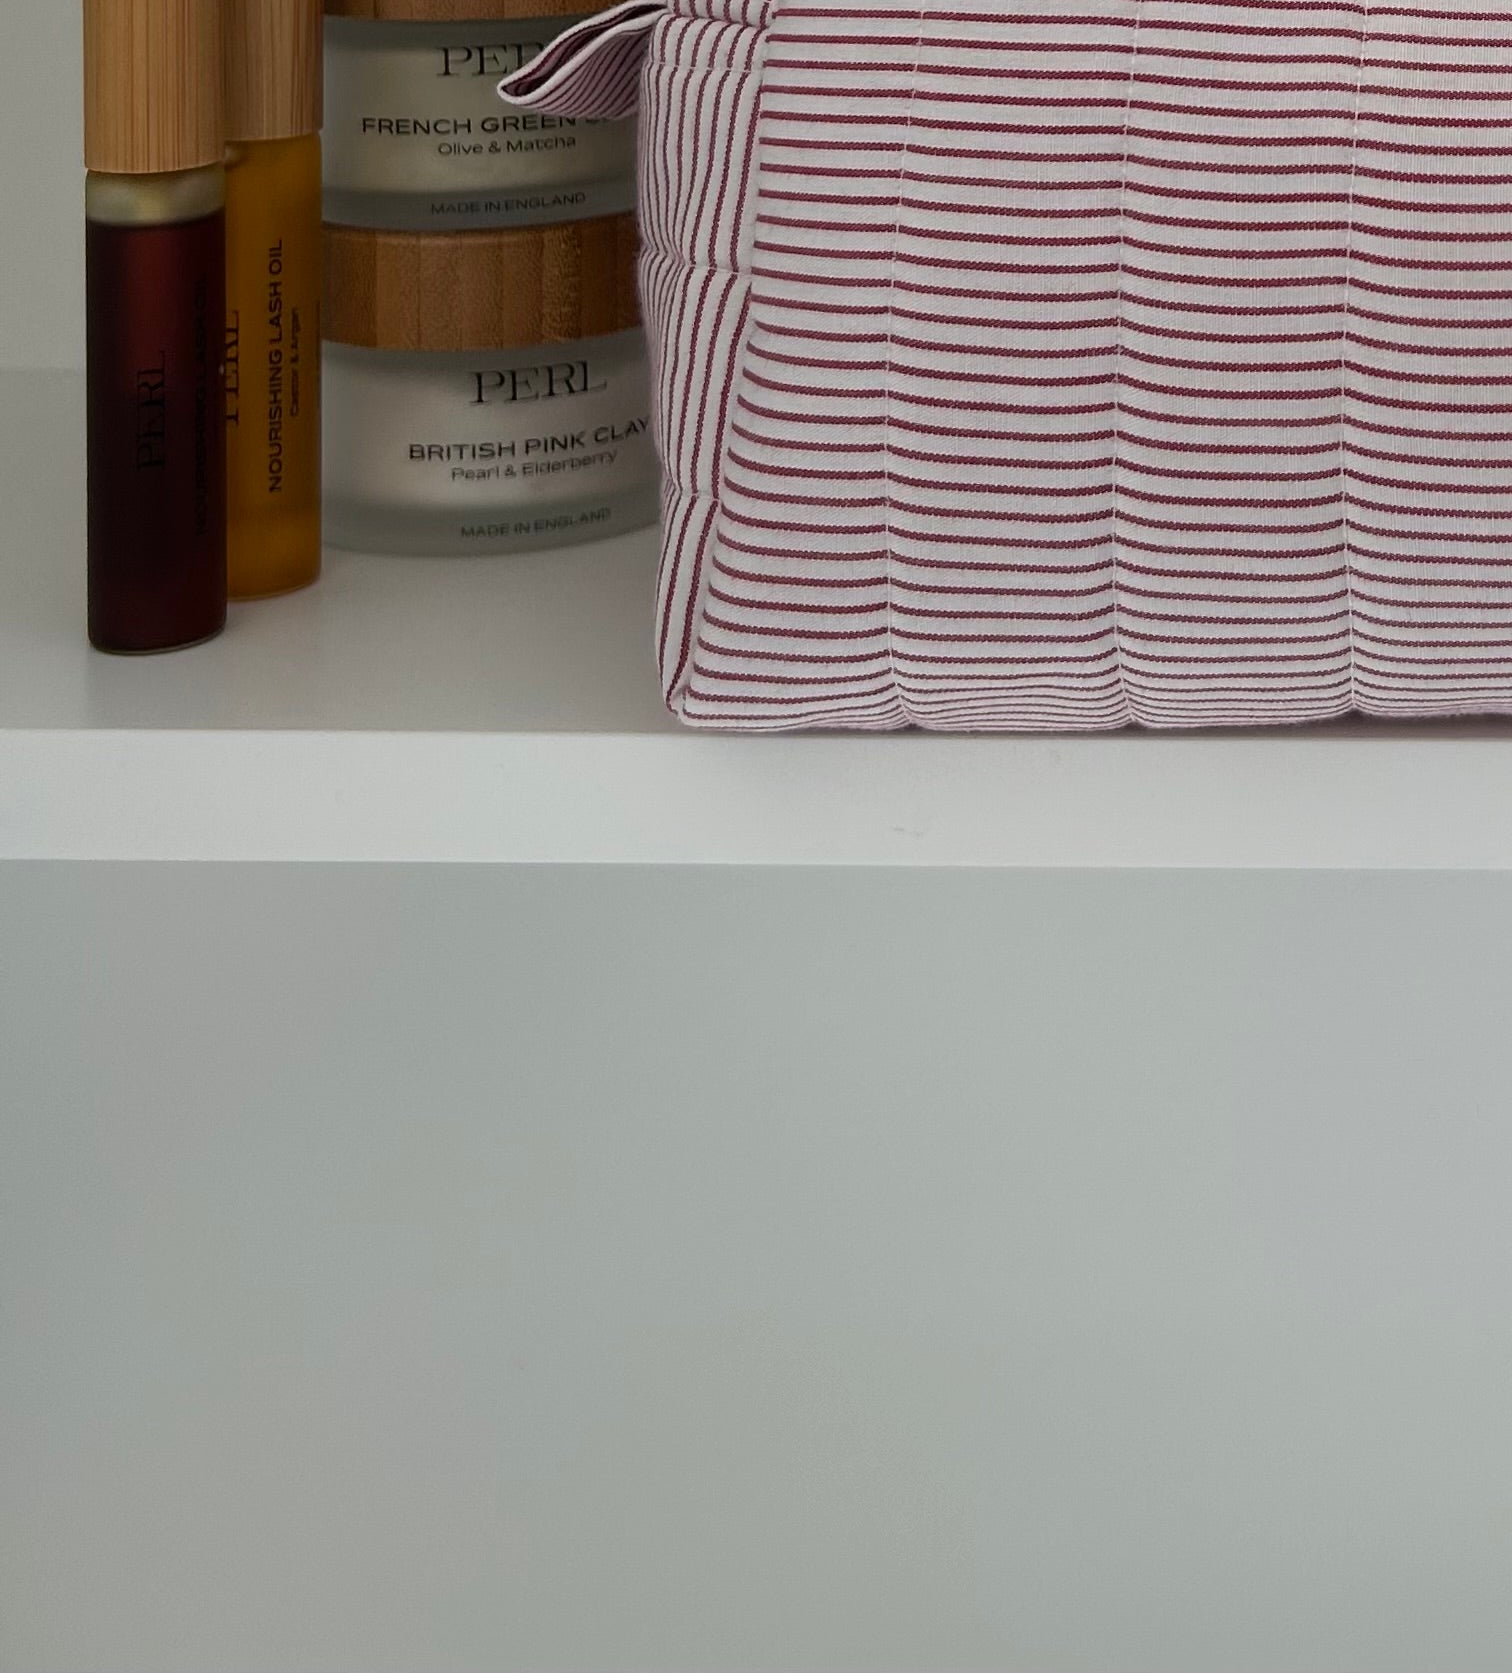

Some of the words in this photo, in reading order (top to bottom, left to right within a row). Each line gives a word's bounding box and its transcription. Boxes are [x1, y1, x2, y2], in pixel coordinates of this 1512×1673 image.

[362, 117, 471, 135] FRENCH
[437, 141, 483, 156] Olive
[488, 140, 501, 154] &
[506, 135, 577, 153] Matcha
[431, 202, 481, 216] MADE
[484, 201, 501, 213] IN
[505, 191, 586, 211] ENGLAND
[268, 240, 283, 275] OIL
[268, 281, 283, 345] LASH
[469, 360, 608, 407] PERL
[136, 350, 167, 472] PERL
[268, 350, 283, 493] NOURISHING
[409, 440, 516, 462] BRITISH
[524, 431, 585, 456] PINK
[593, 416, 650, 444] CLAY
[451, 466, 500, 481] Pearl
[505, 464, 517, 478] &
[523, 448, 618, 476] Elderberry
[461, 523, 509, 538] MADE
[514, 521, 531, 534] IN
[534, 506, 611, 531] ENGLAND
